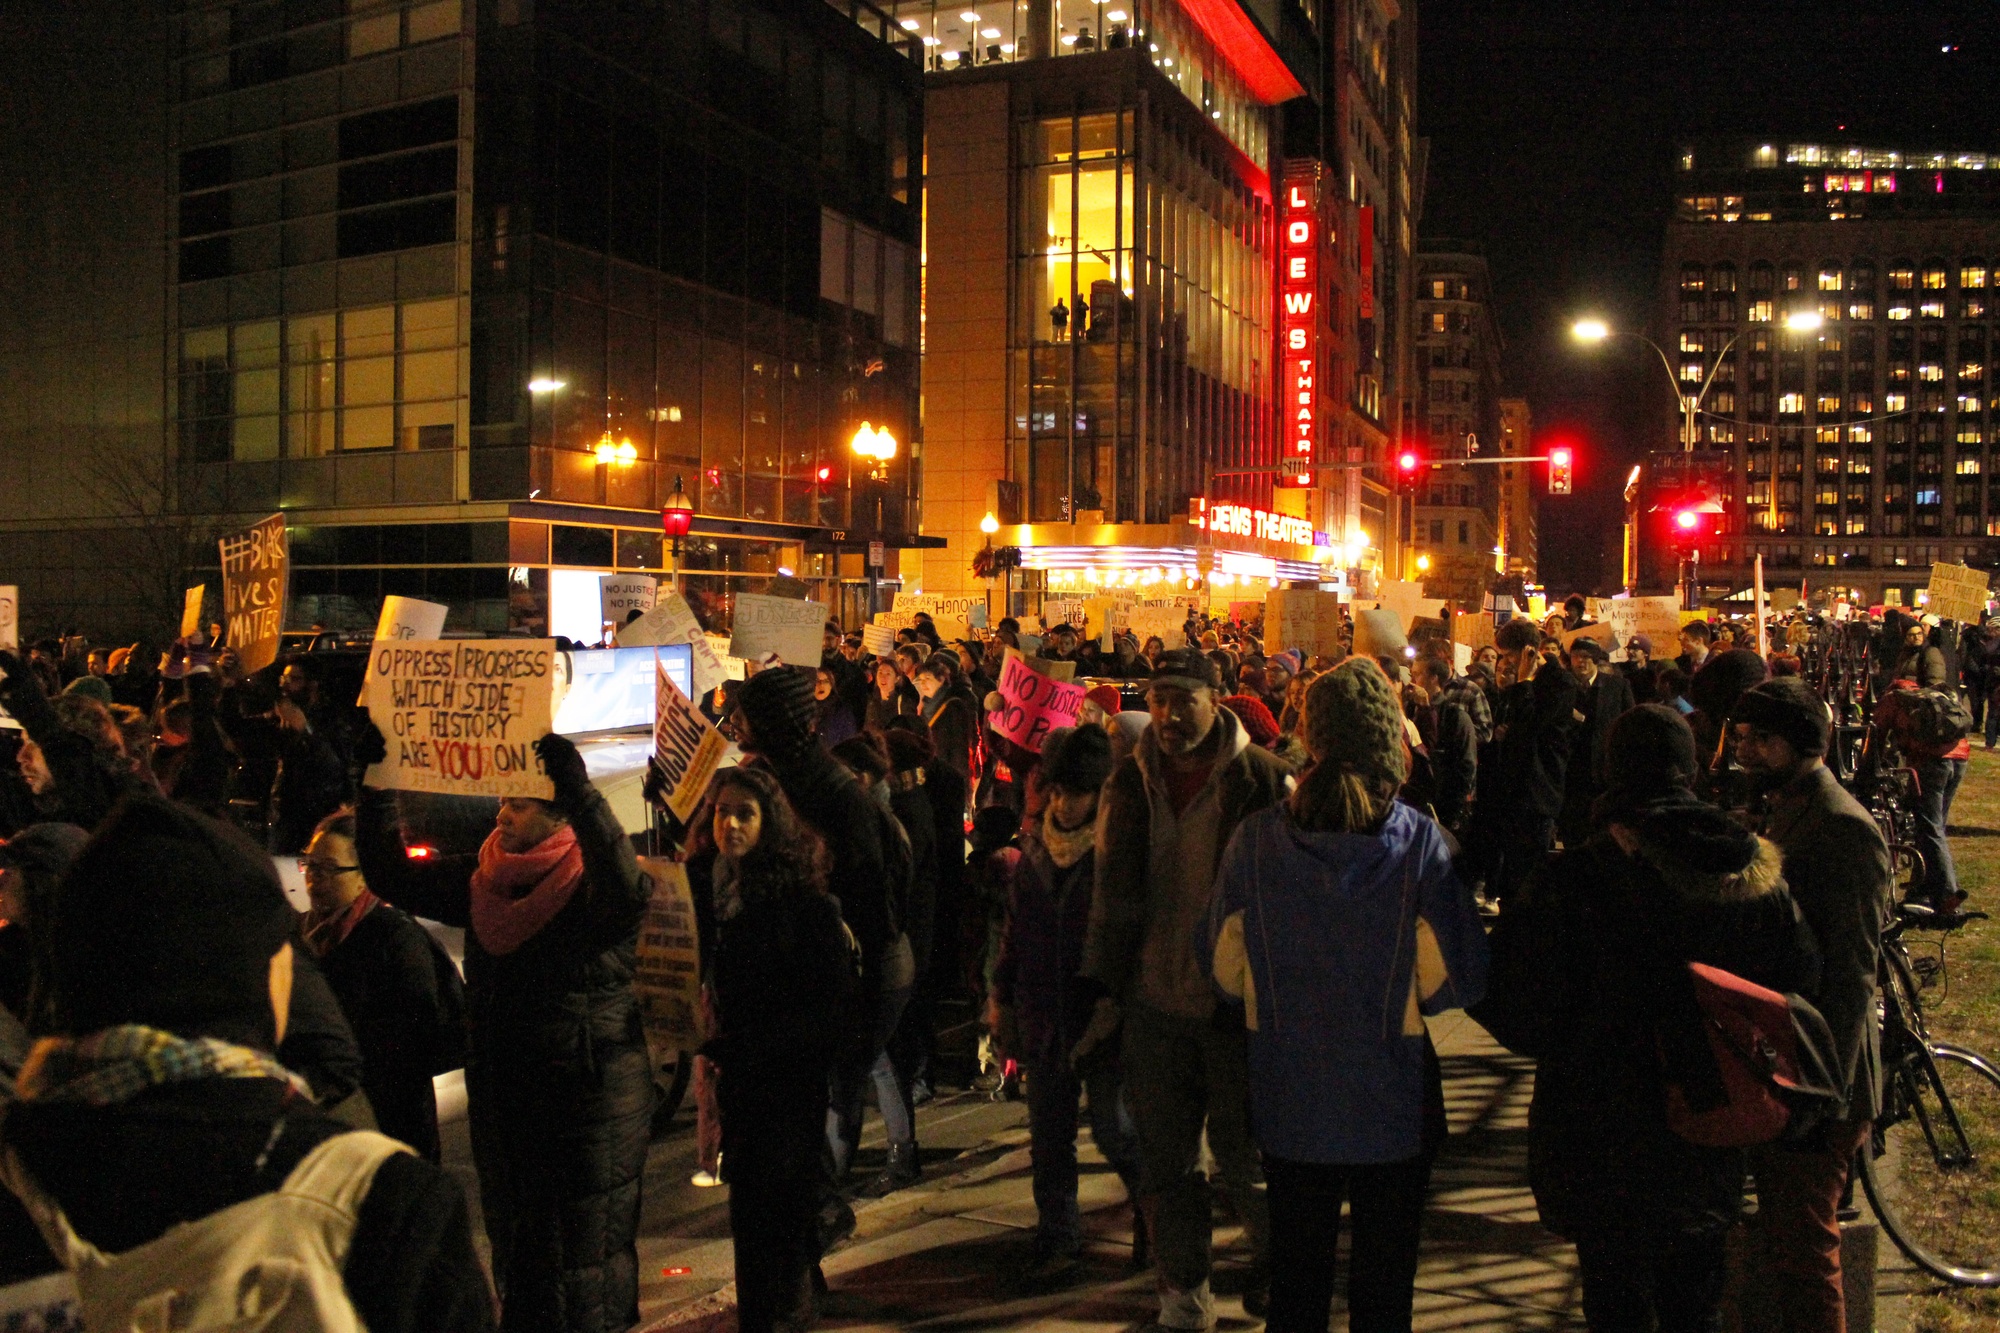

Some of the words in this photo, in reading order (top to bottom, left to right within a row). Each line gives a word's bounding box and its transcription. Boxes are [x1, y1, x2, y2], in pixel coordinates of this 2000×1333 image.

[1285, 187, 1312, 350] LOEWS
[1297, 359, 1313, 485] THEATRS
[832, 531, 846, 541] 172
[1199, 499, 1252, 536] OEWS
[1254, 510, 1313, 546] THEATRES
[605, 585, 620, 594] NO
[622, 584, 654, 597] JUSTICE
[610, 599, 624, 608] NO
[627, 599, 651, 610] PEACE
[226, 607, 279, 649] MATTER
[391, 679, 454, 708] WHICH
[461, 682, 513, 711] SIDE
[1006, 663, 1039, 702] NO
[392, 711, 417, 738] OF
[430, 711, 512, 740] HISTORY
[400, 741, 430, 768] ARE
[432, 739, 483, 780] YOU
